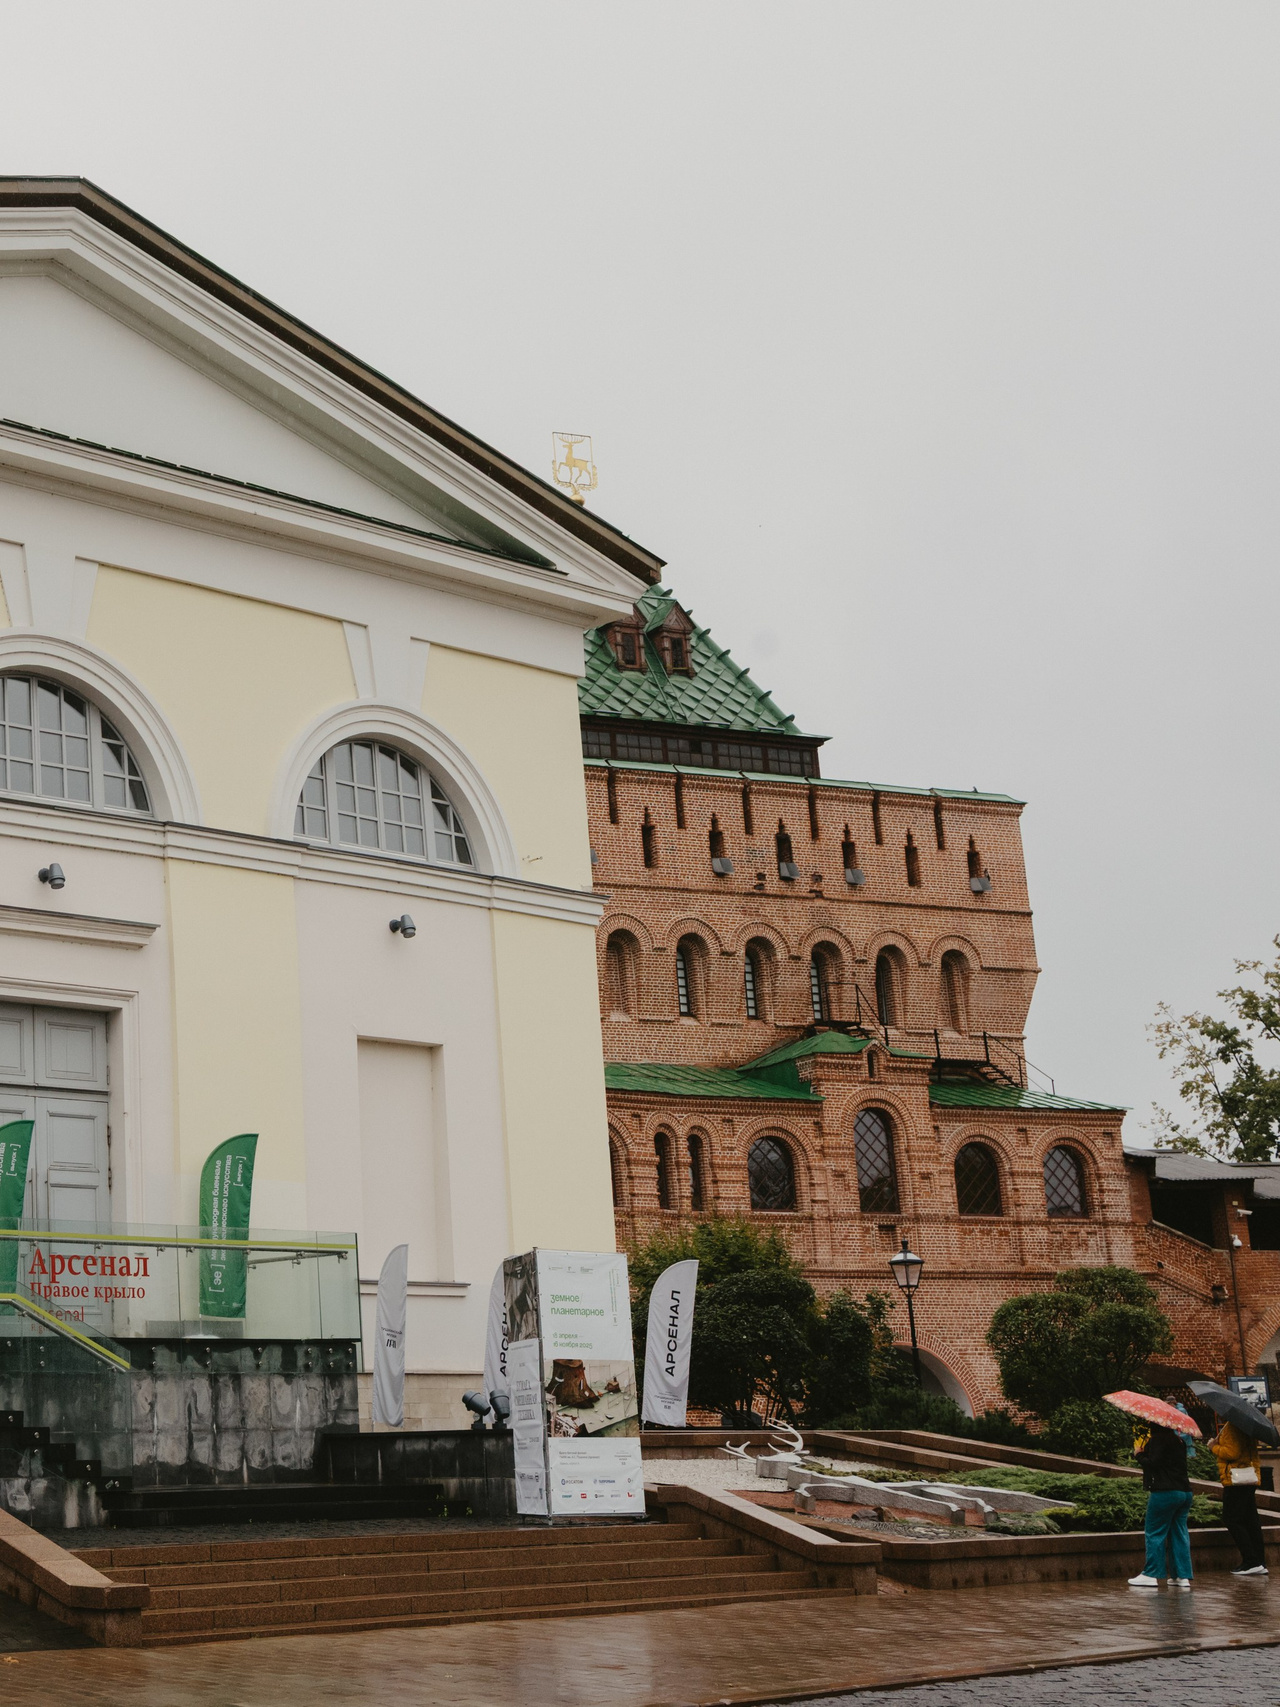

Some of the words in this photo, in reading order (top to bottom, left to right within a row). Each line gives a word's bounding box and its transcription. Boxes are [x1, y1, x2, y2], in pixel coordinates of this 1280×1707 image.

[211, 1159, 222, 1196] биеннале
[222, 1155, 233, 1197] искусства
[211, 1198, 222, 1261] меународная
[221, 1198, 229, 1261] экогического
[28, 1248, 150, 1284] Арсенал
[30, 1282, 89, 1300] Правое
[94, 1287, 146, 1303] крыло
[33, 1306, 85, 1322] senal
[550, 1307, 605, 1318] планетарное
[500, 1302, 509, 1377] АРСЕН
[559, 1341, 578, 1349] ноября
[665, 1290, 681, 1377] АРСЕНАЛ
